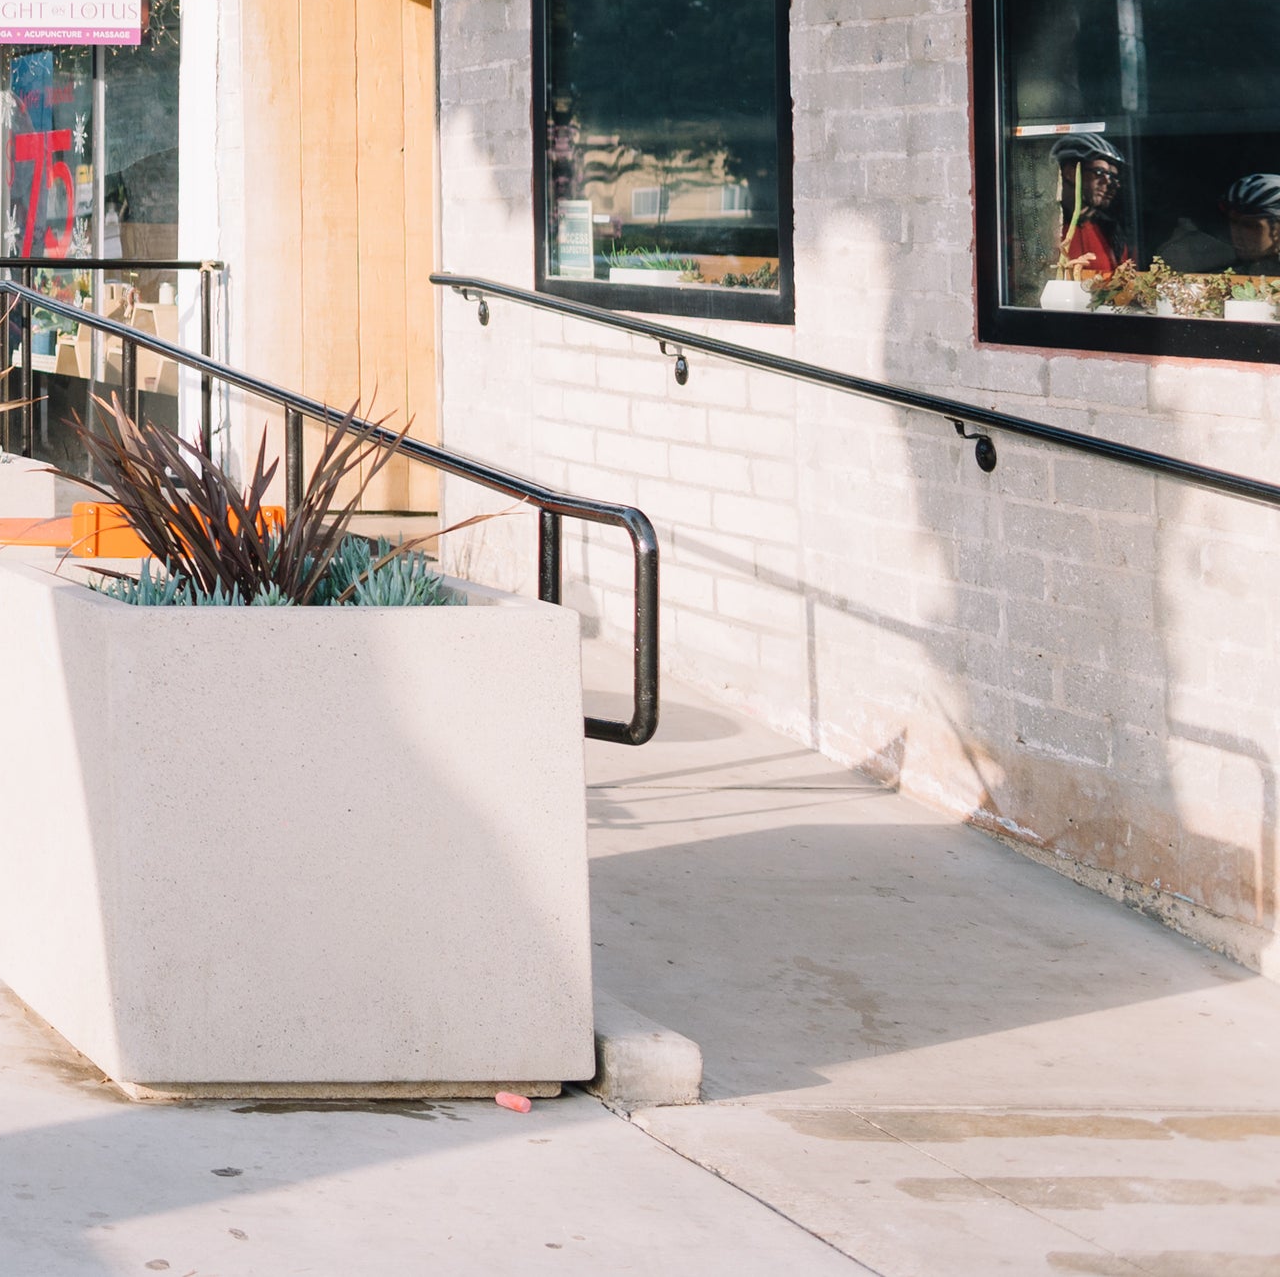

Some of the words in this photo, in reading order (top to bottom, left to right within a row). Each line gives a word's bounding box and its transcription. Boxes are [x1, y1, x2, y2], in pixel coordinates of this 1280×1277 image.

[70, 2, 138, 20] LOTUS
[24, 31, 82, 39] ACUPUNCTURE
[93, 31, 130, 39] MASSAGE
